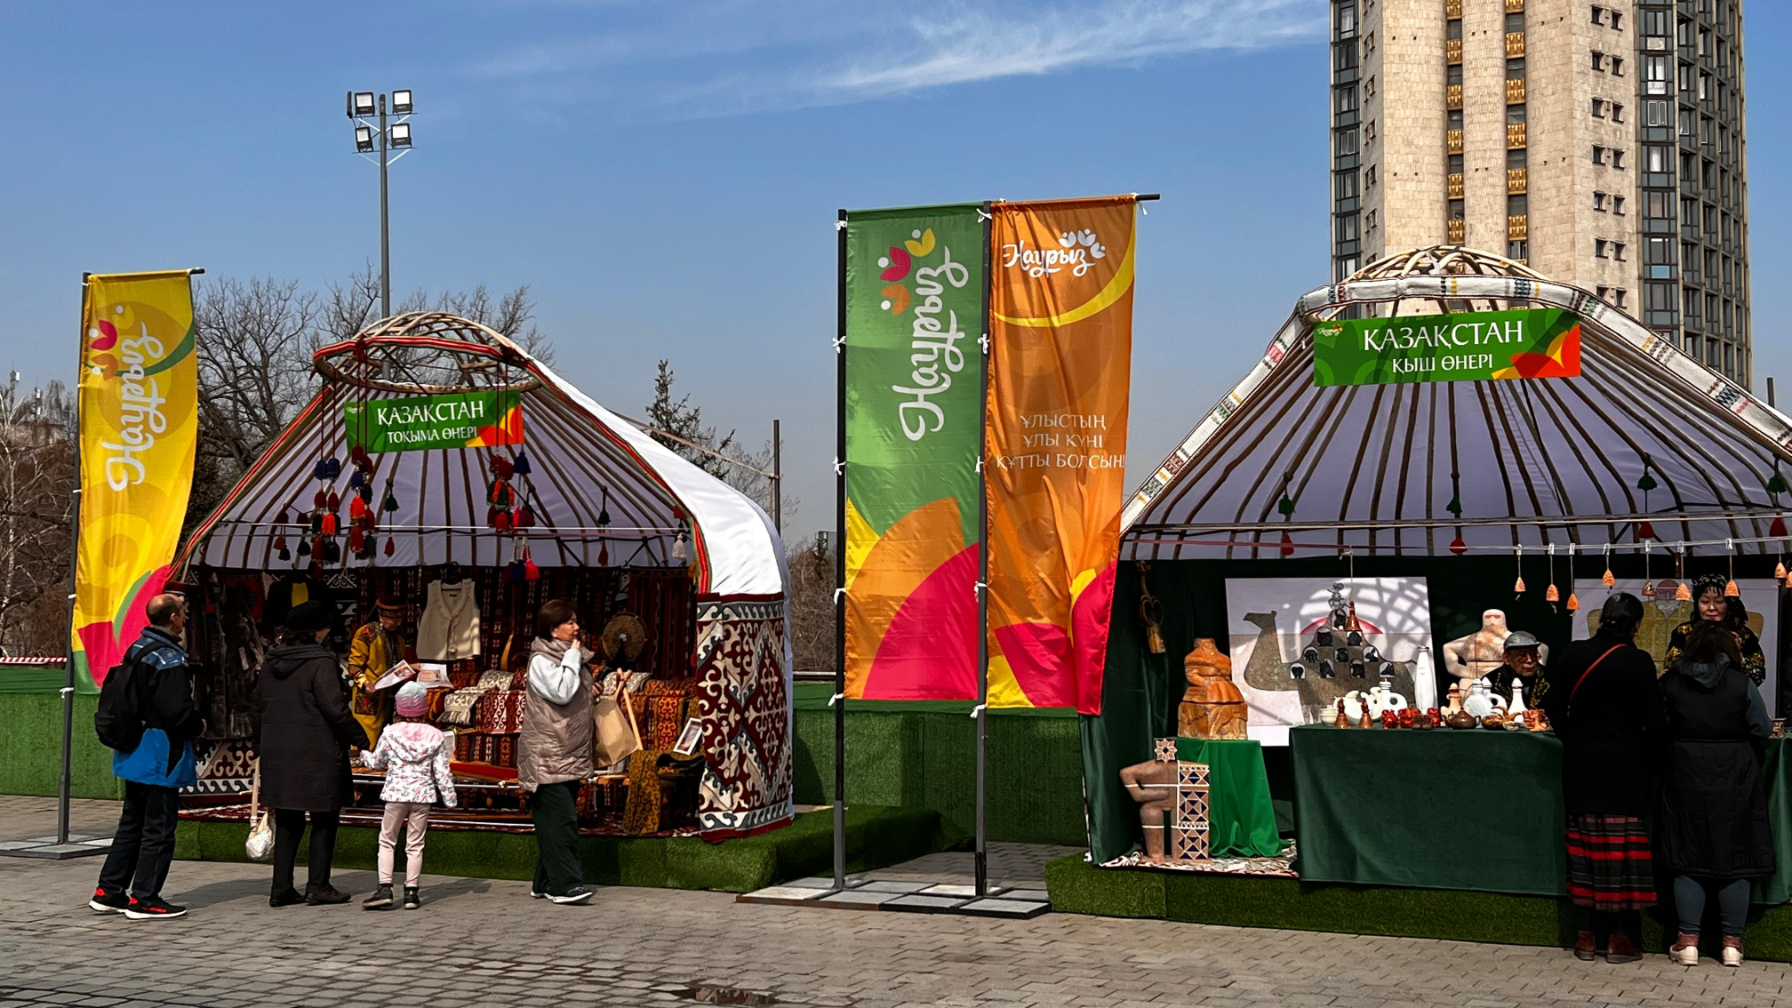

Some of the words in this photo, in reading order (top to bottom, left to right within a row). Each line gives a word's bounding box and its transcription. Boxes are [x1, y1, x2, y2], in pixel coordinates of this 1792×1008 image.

[1003, 239, 1096, 278] Наурыз
[892, 246, 969, 441] Наурыз
[1363, 320, 1523, 353] ҚАЗАҚСТАН
[1392, 357, 1436, 374] ҚЫШ
[1441, 353, 1494, 371] ӨНЕРІ
[102, 321, 167, 492] Наурыз
[377, 400, 484, 427] ҚАЗАҚСТАН
[1020, 413, 1107, 431] ҰЛЫСТЫҢ
[387, 428, 440, 444] ТОҚЫМА
[441, 425, 478, 440] ӨНЕРІ
[1022, 433, 1060, 448] ҰЛЫ
[1065, 434, 1103, 448] КҮНІ
[996, 453, 1050, 471] ҚҰТТЫ
